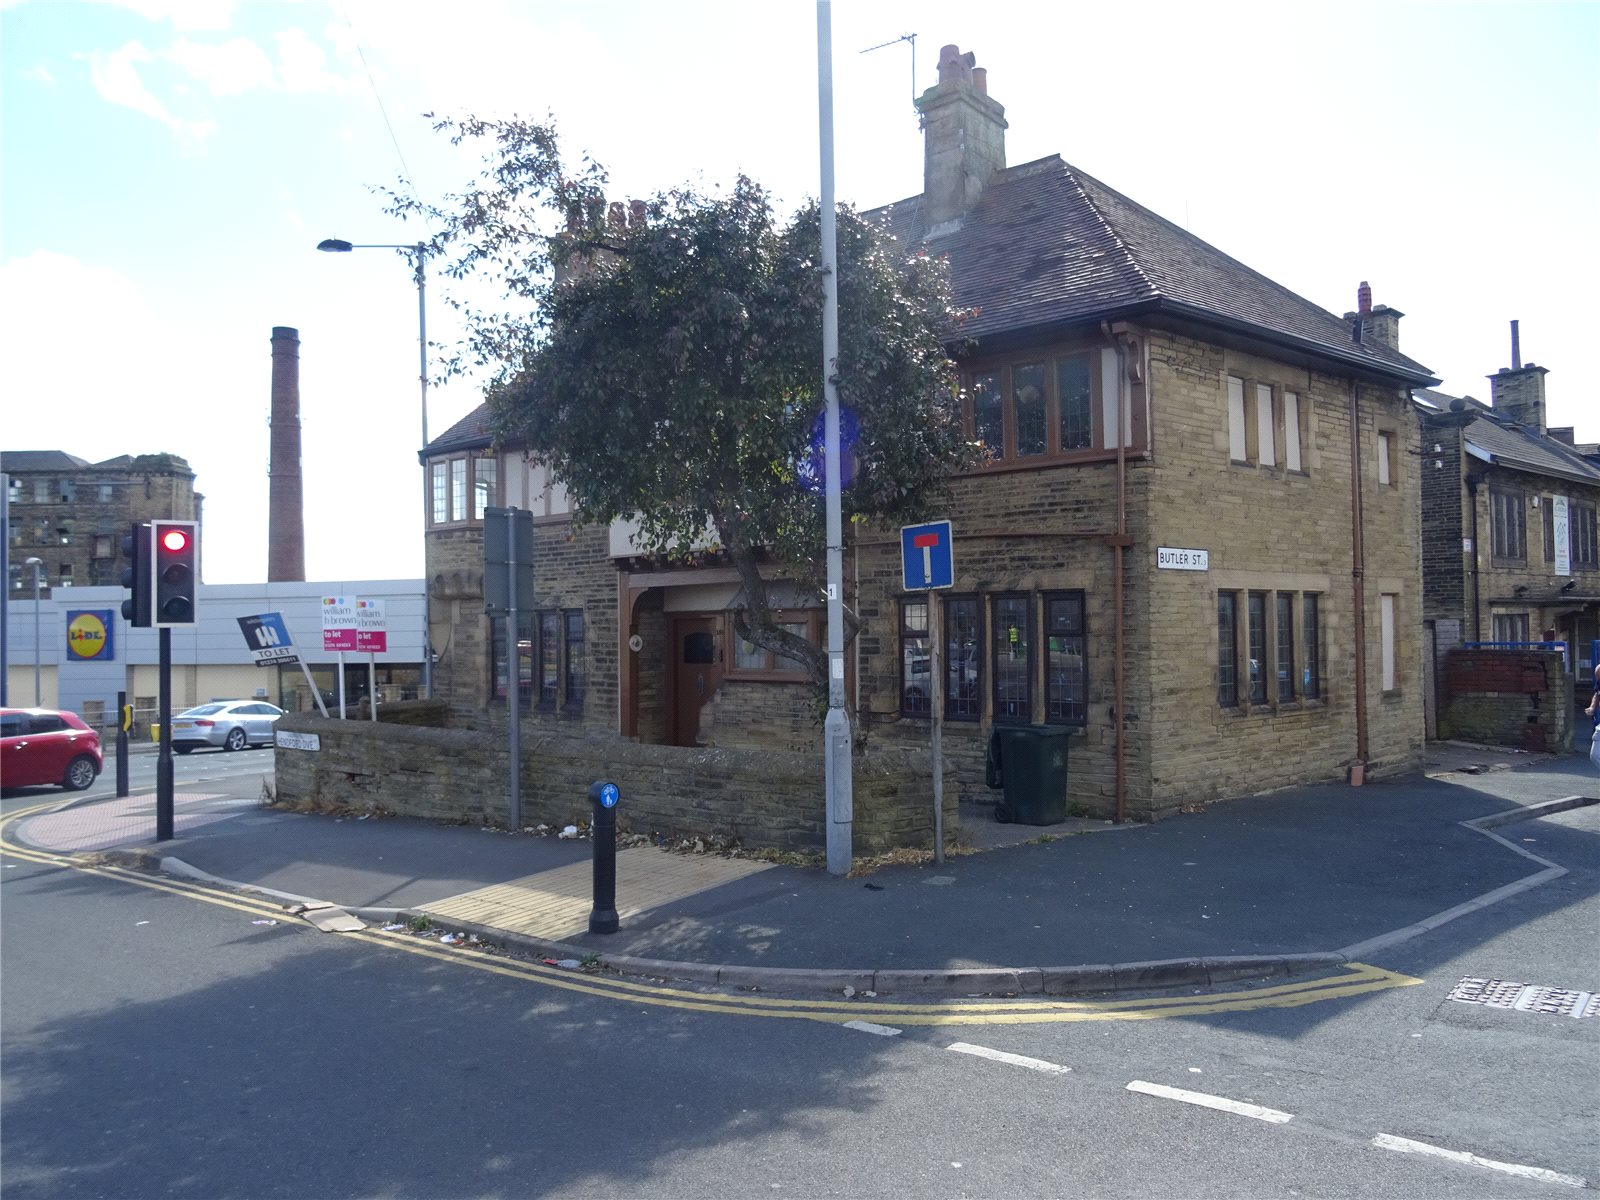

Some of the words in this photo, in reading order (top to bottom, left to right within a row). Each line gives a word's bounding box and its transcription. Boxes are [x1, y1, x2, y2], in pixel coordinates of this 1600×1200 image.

[1160, 552, 1189, 565] BUTLER
[323, 606, 351, 615] william
[330, 616, 357, 625] brown
[361, 618, 386, 627] brown
[332, 630, 342, 638] let
[258, 650, 273, 658] TO
[273, 647, 290, 656] LET
